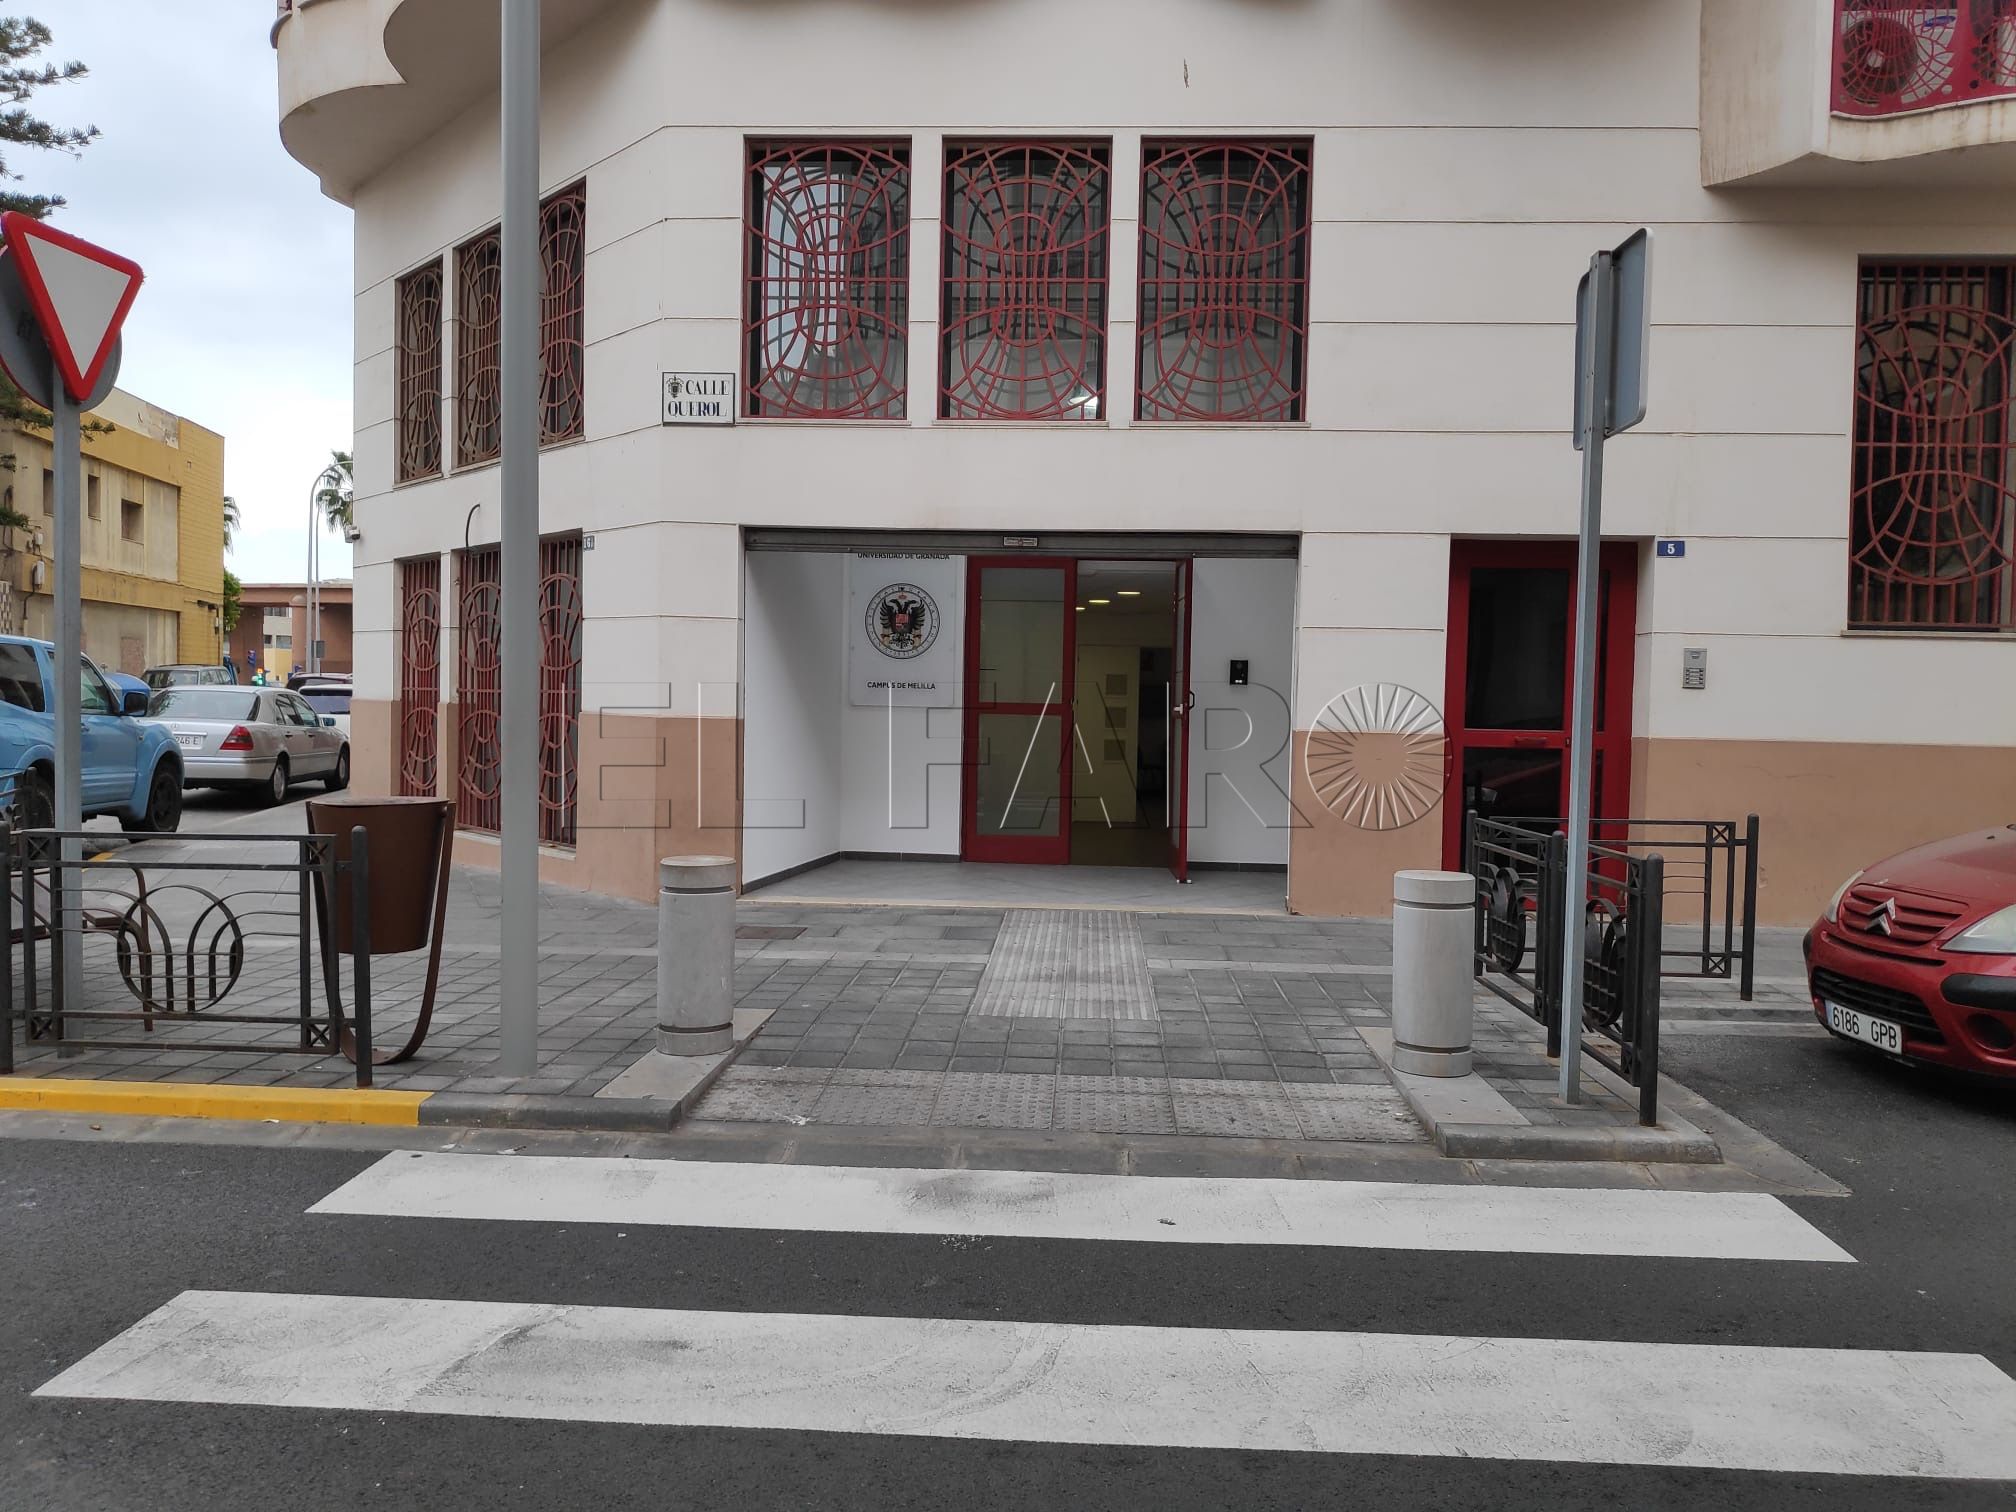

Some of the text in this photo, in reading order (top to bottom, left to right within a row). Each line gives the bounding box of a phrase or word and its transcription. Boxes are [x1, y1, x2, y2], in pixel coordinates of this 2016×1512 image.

[685, 379, 729, 396] CALLE
[668, 400, 728, 418] QUEROL
[1667, 543, 1675, 554] 5
[866, 681, 896, 689] CAMPUS
[907, 682, 936, 690] MELILLA
[1832, 1006, 1897, 1049] 6186 GPB
